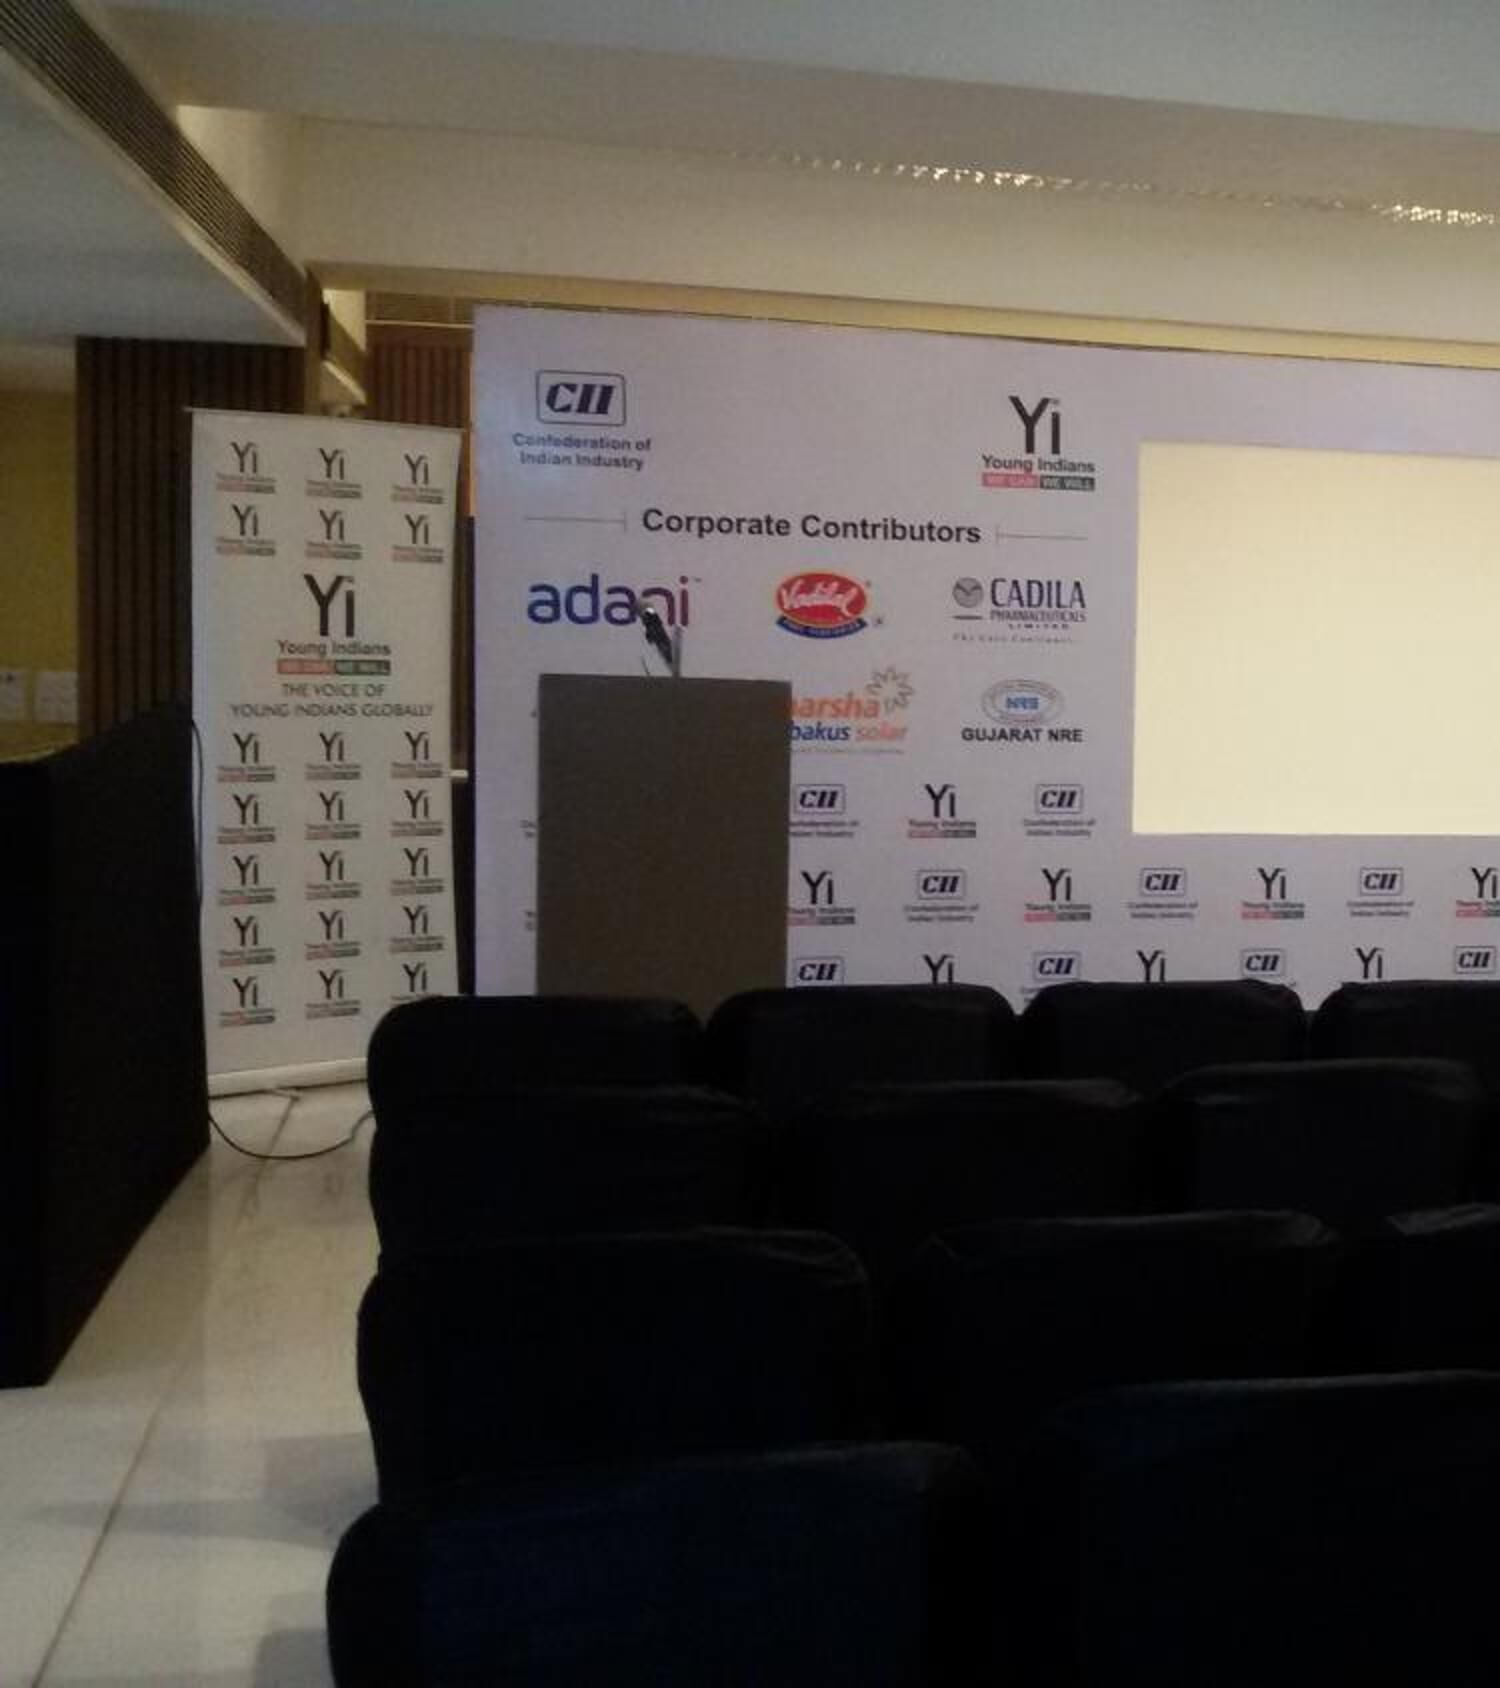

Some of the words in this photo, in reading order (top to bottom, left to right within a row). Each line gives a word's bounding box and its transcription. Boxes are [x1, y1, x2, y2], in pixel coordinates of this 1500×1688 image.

[546, 383, 616, 414] CII
[1009, 396, 1061, 454] Yi
[512, 432, 631, 450] Confederation
[635, 438, 652, 451] of
[404, 454, 429, 485] Yi
[520, 452, 571, 467] Indian
[576, 454, 644, 472] Industry
[982, 455, 1033, 473] Young
[1038, 458, 1096, 473] Indians
[642, 508, 791, 538] Corporate
[801, 515, 982, 544] Contributors
[304, 574, 355, 637] Yi
[527, 573, 690, 627] adani
[991, 577, 1086, 609] CADILA
[791, 691, 880, 718] arsha
[788, 721, 851, 741] bakus
[961, 727, 1042, 742] GUJARAT
[1048, 729, 1083, 743] NRE
[925, 784, 956, 817] Yi
[801, 871, 833, 905] Yi
[1042, 868, 1072, 901] Yi
[1258, 868, 1287, 899] Yi
[1471, 868, 1498, 898] Yi
[923, 954, 955, 983] Yi
[1137, 950, 1166, 982] Yi
[1356, 948, 1384, 979] Yi
